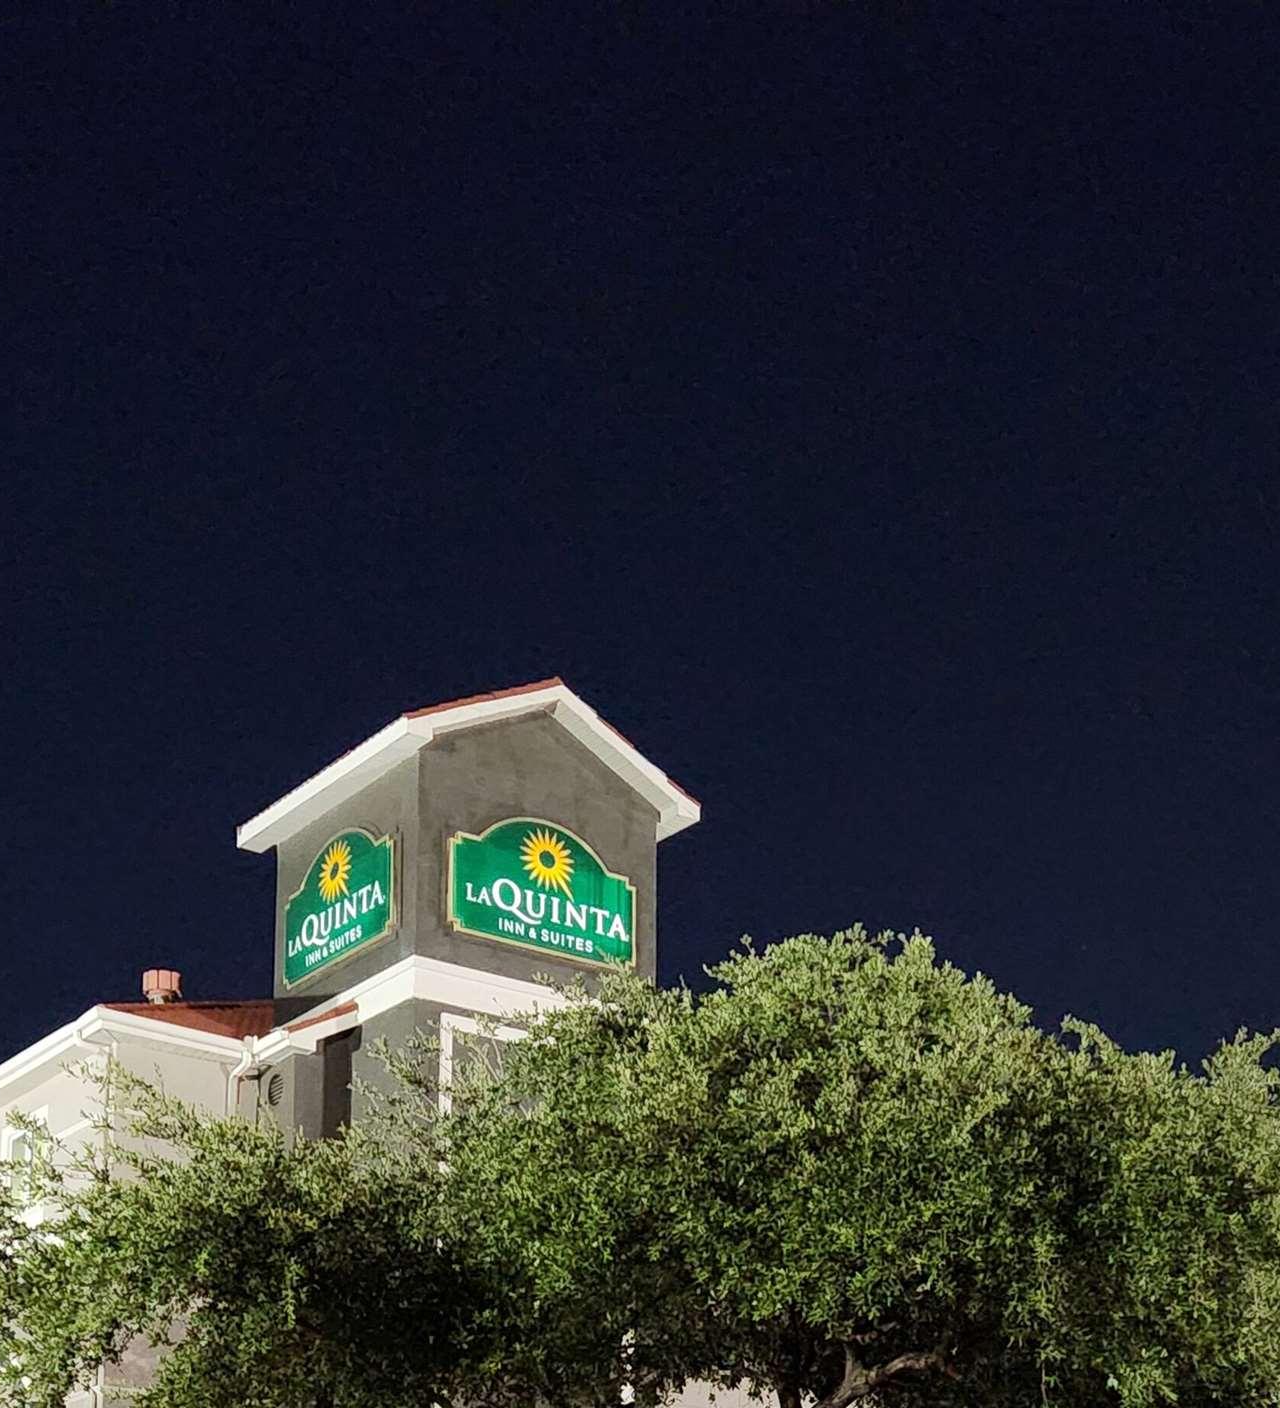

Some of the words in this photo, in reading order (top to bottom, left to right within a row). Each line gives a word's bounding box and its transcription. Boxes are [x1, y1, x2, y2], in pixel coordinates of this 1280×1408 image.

[305, 949, 321, 967] INN
[329, 925, 362, 953] SUITES
[498, 917, 525, 936] INN
[528, 928, 537, 939] &
[540, 928, 593, 953] SUITES
